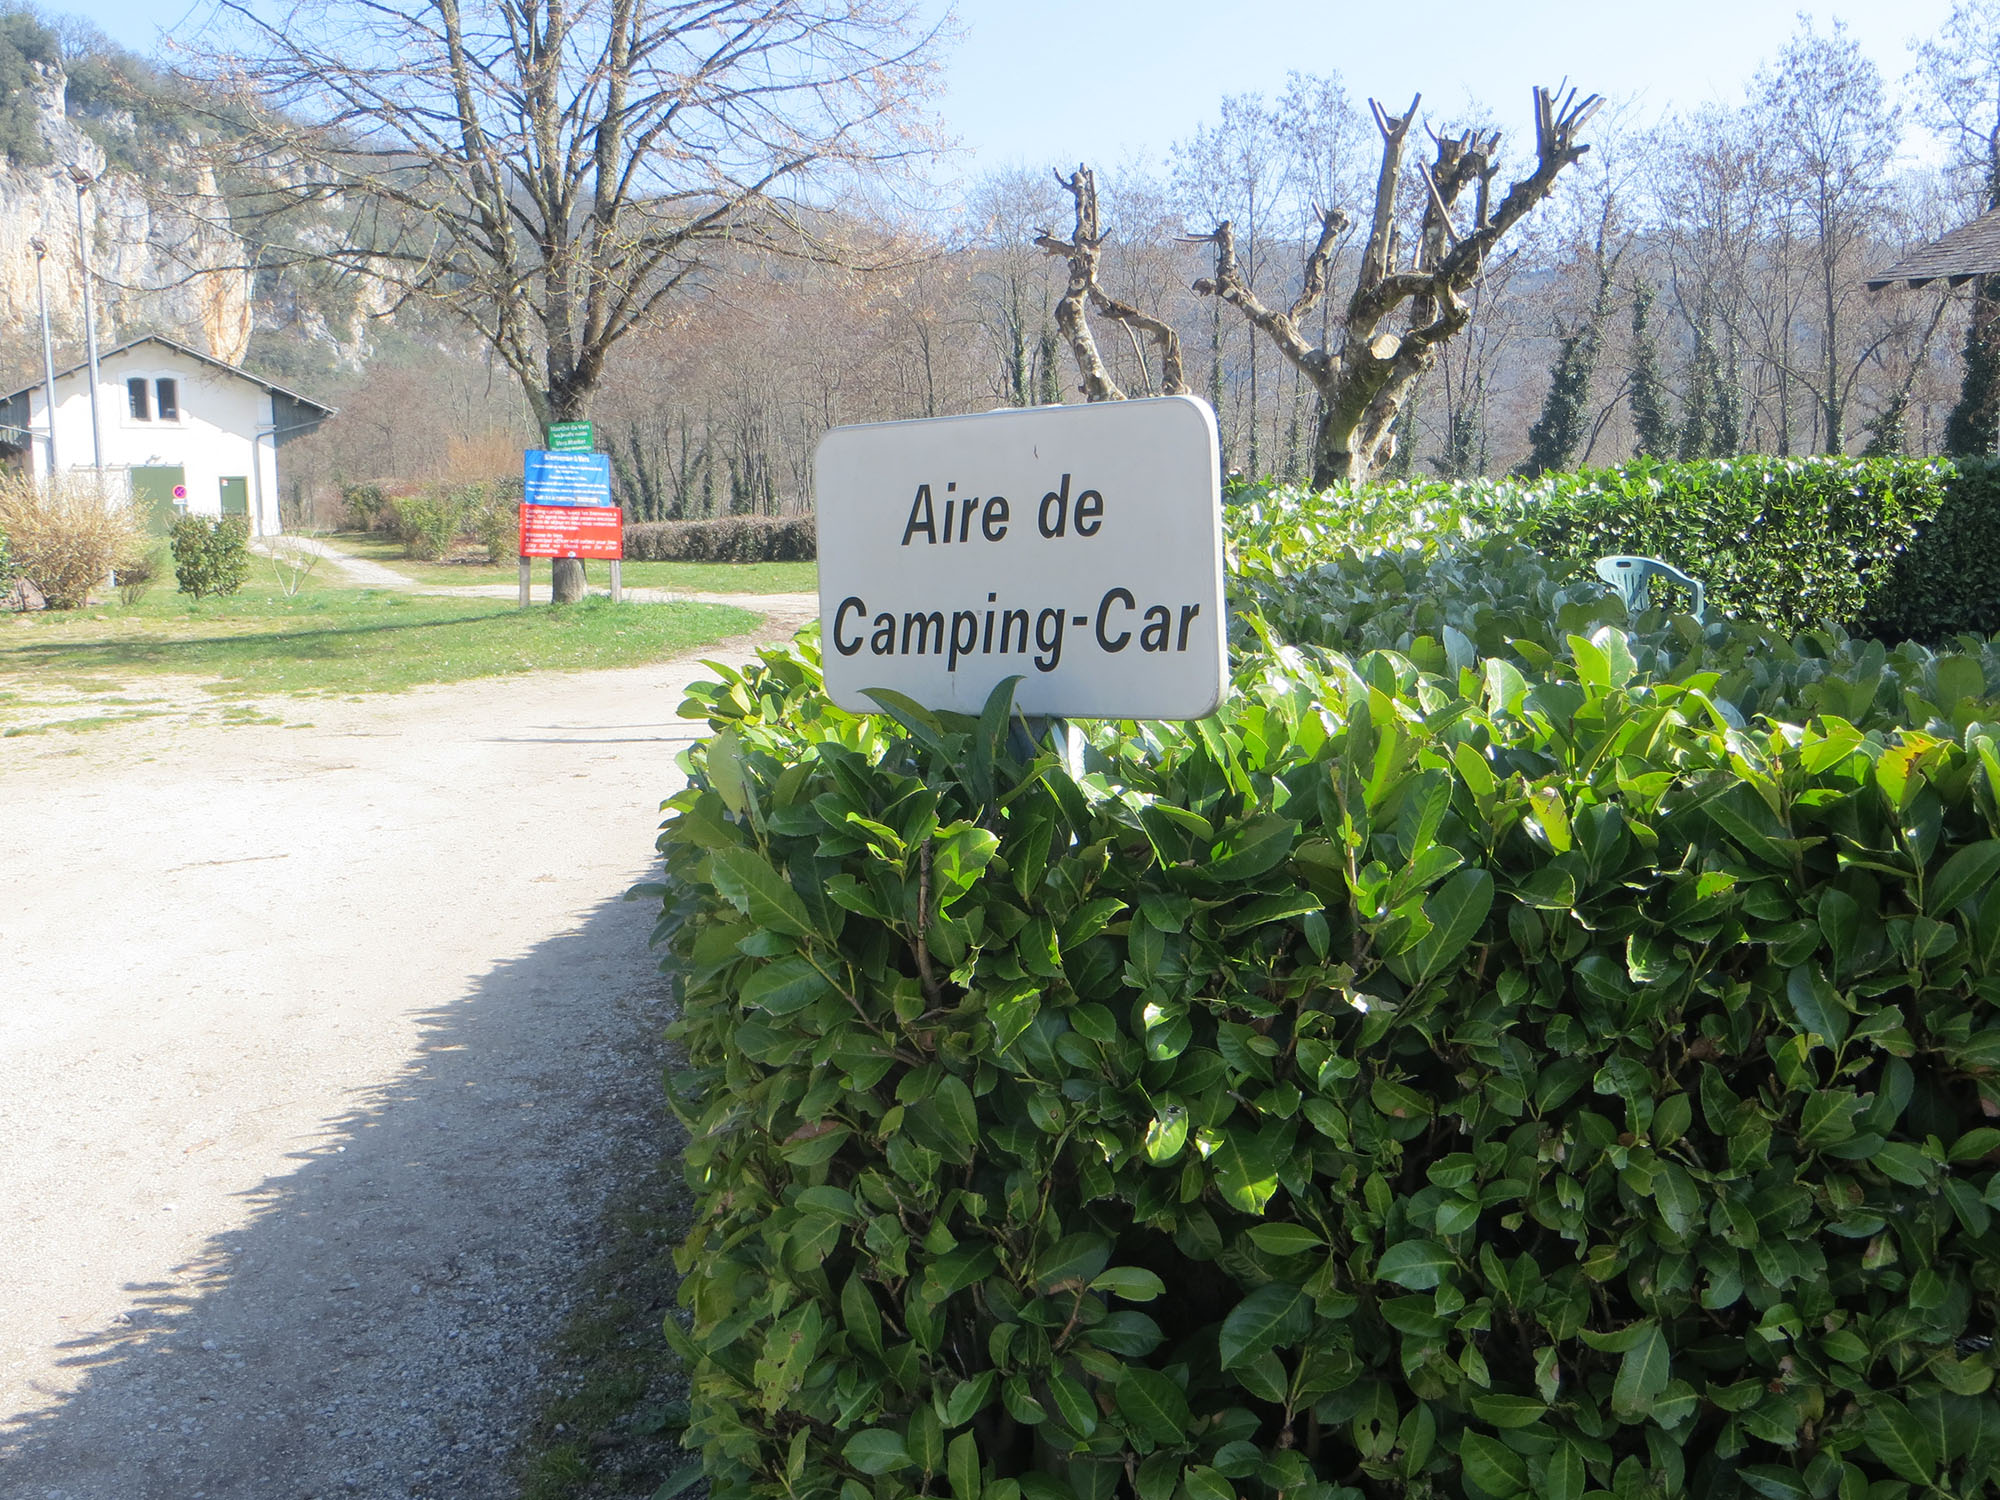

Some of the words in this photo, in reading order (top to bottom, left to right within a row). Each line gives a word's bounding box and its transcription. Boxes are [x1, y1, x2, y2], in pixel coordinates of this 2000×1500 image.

[902, 482, 1010, 546] Aire
[1038, 474, 1104, 539] de
[833, 587, 1200, 672] Camping-Car
